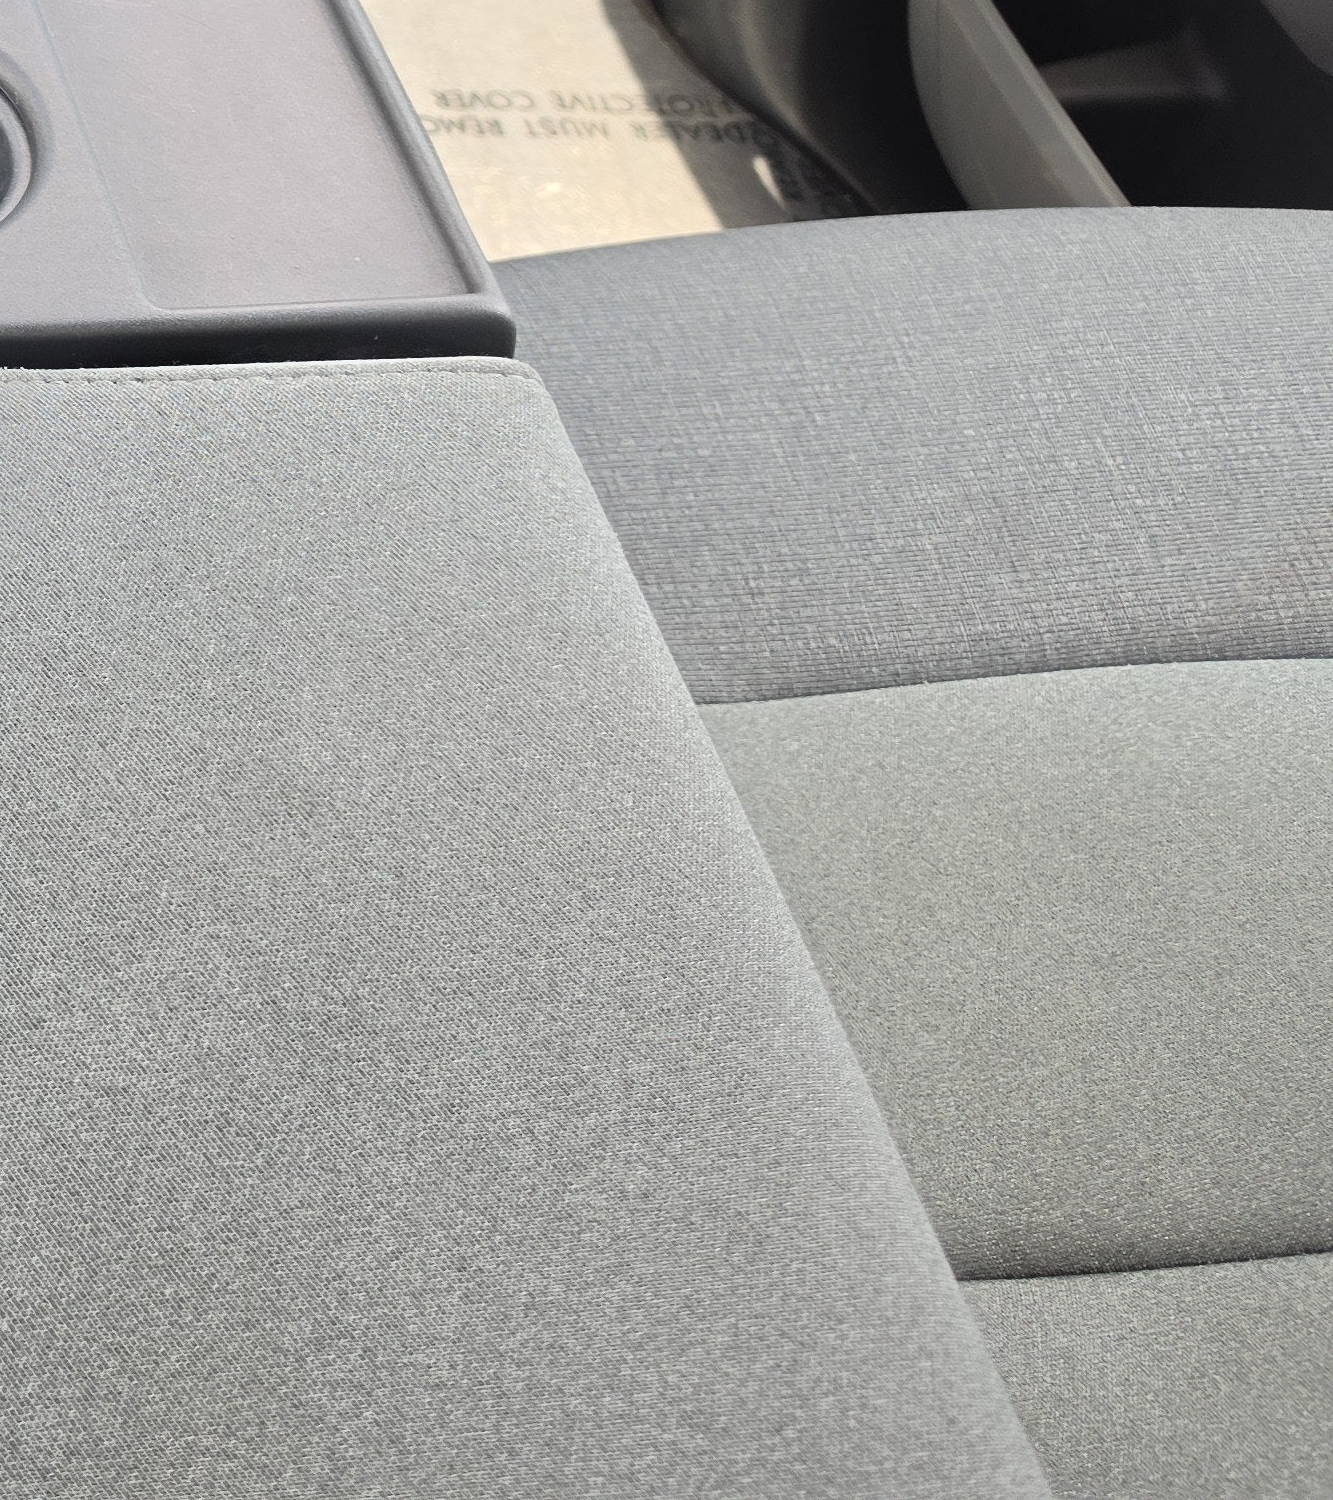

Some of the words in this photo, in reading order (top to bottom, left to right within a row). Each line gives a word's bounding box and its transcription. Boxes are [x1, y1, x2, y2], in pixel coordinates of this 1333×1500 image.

[431, 88, 536, 112] COVER
[420, 113, 505, 139] REMO
[522, 114, 610, 141] MUST
